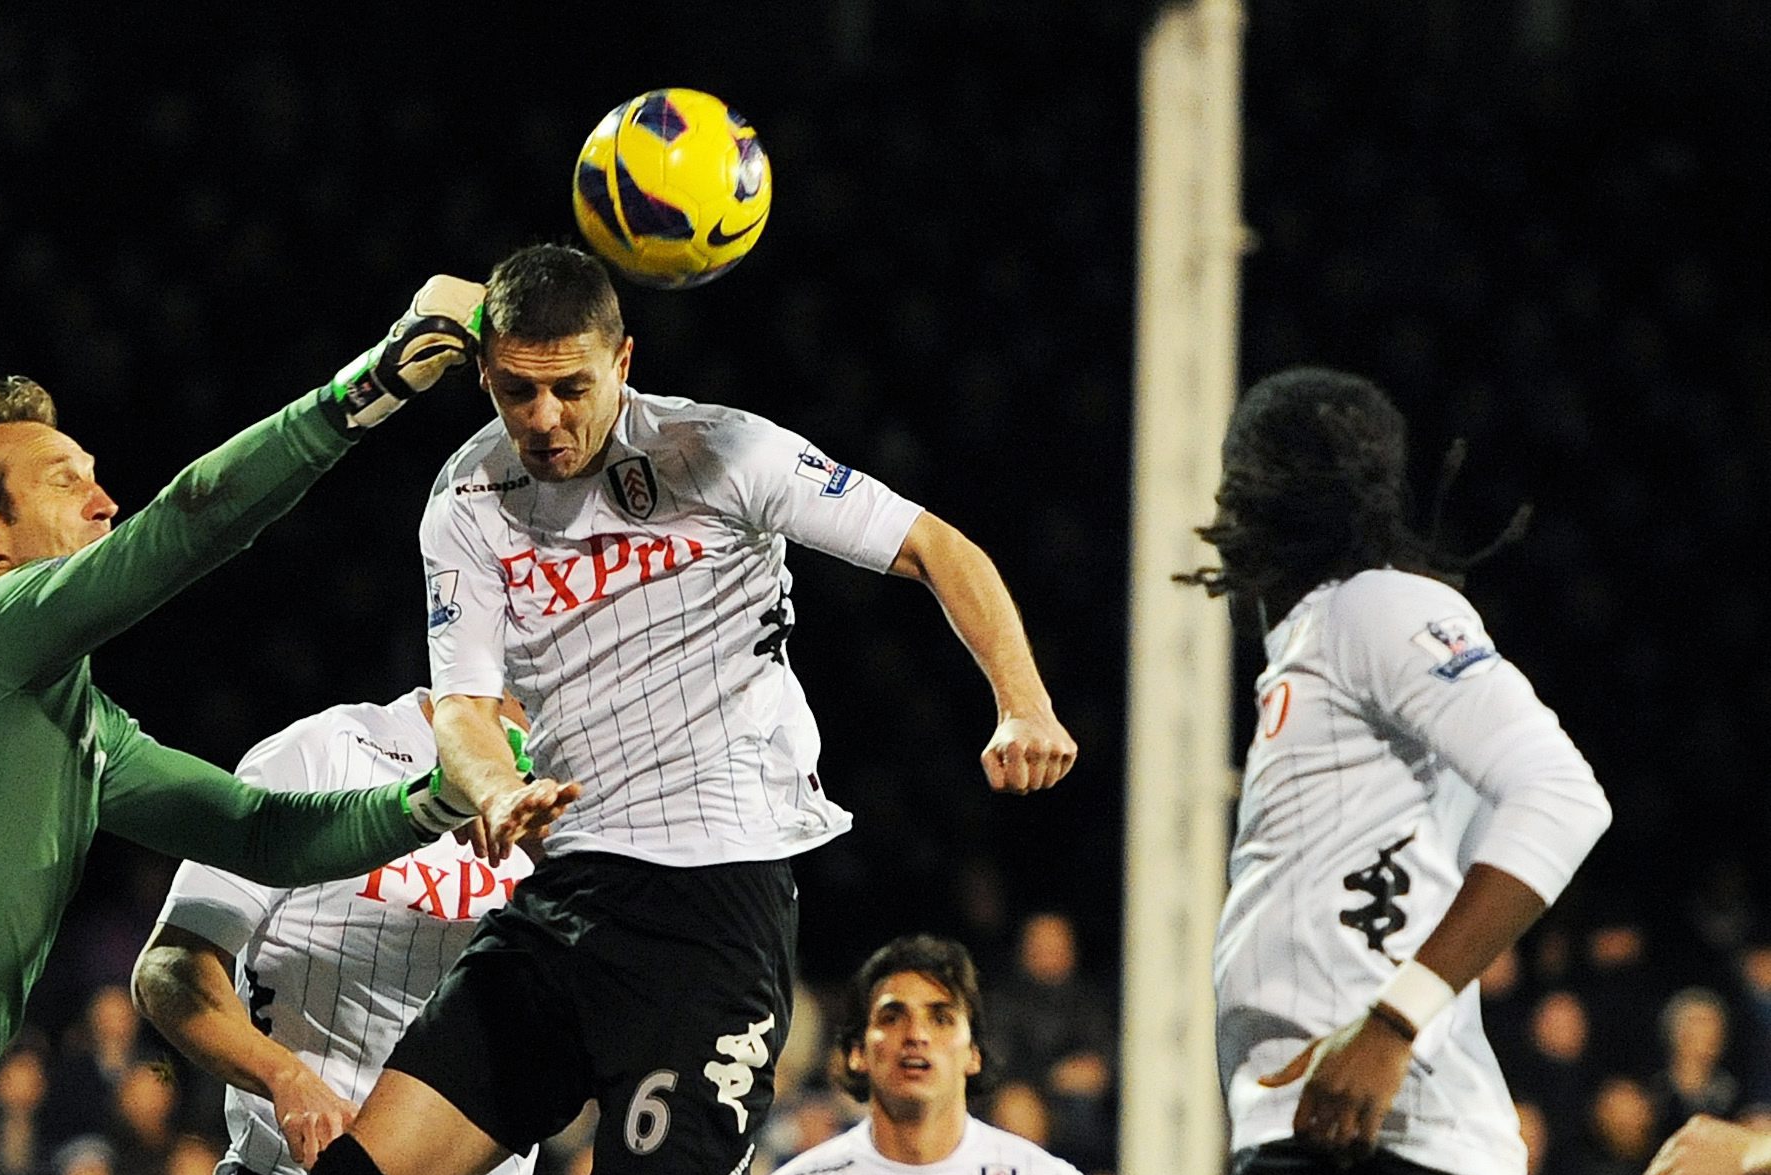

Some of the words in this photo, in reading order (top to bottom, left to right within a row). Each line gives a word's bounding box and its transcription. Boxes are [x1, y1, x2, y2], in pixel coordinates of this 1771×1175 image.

[500, 532, 704, 620] FxPro
[356, 852, 521, 920] FxPr
[624, 1068, 679, 1155] 6
